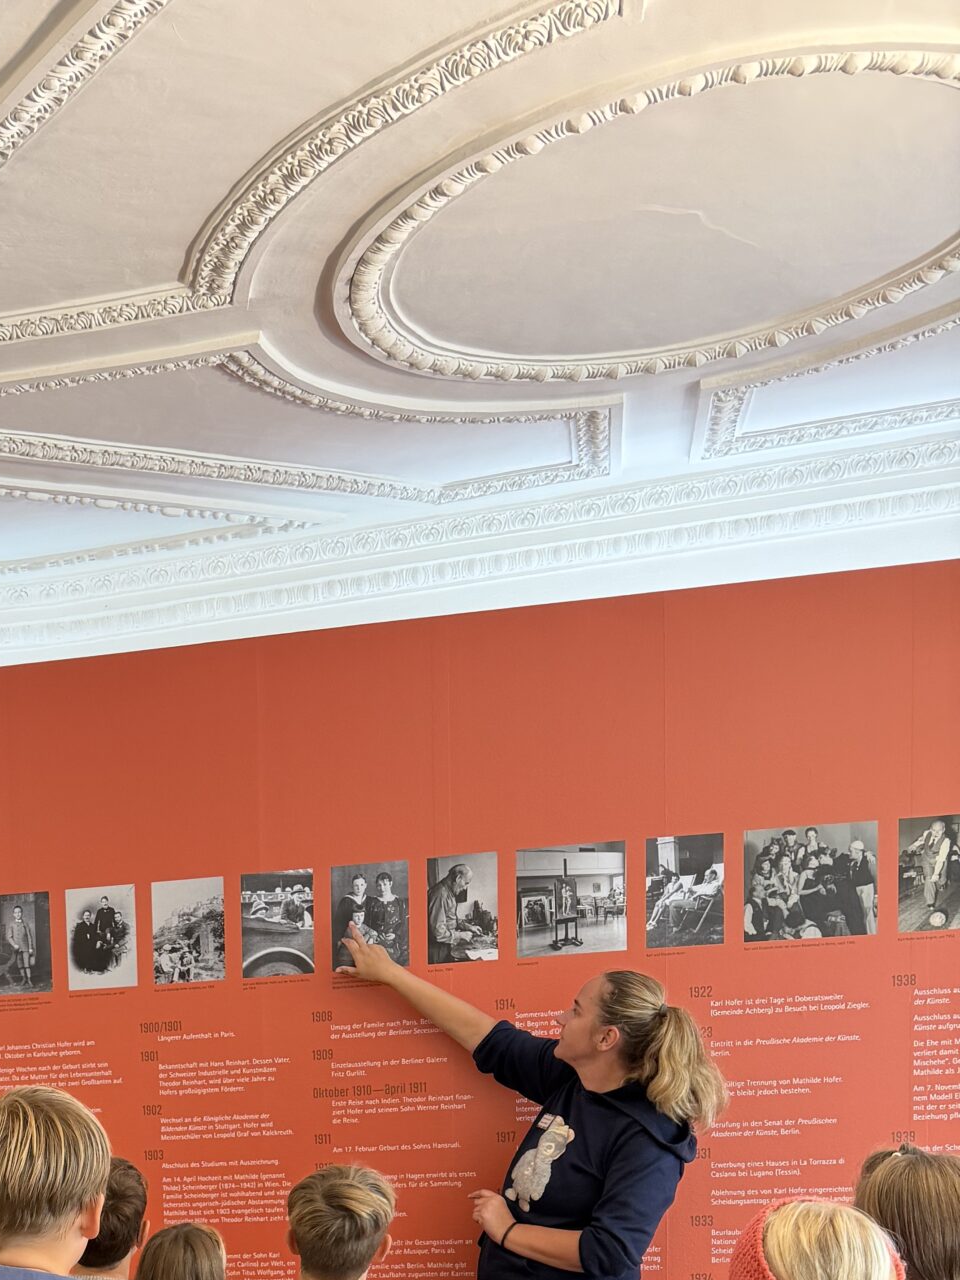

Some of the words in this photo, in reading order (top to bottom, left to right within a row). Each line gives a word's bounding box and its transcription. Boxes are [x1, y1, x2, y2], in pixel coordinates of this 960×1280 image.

[892, 974, 916, 986] 1938
[690, 986, 712, 997] 1922
[495, 999, 515, 1010] 1914
[710, 999, 723, 1007] Karl
[725, 998, 743, 1006] Hofer
[745, 997, 753, 1005] ist
[755, 997, 767, 1005] drei
[769, 996, 785, 1005] Tage
[795, 993, 843, 1002] Doberatsweiler
[710, 1007, 743, 1018] (Gemeinde
[745, 1006, 774, 1015] Achberg)
[785, 1004, 807, 1012] Besuch
[809, 1003, 819, 1011] bei
[820, 1002, 845, 1012] Leopold
[847, 1001, 870, 1011] Ziegler.
[312, 1011, 332, 1022] 1908
[140, 1021, 182, 1033] 1900/1901
[330, 1023, 351, 1031] Umzug
[363, 1020, 384, 1028] Familie
[386, 1019, 401, 1027] nach
[402, 1018, 418, 1026] Paris.
[341, 1030, 375, 1039] Ausstellung
[389, 1028, 412, 1036] Berliner
[710, 1039, 733, 1048] Eintritt
[743, 1038, 753, 1046] die
[914, 1039, 925, 1047] Die
[941, 1038, 952, 1046] mit
[140, 1051, 159, 1061] 1901
[312, 1049, 333, 1060] 1909
[913, 1048, 937, 1057] verliert
[939, 1047, 959, 1055] damit
[331, 1059, 381, 1068] Einzelausstellung
[382, 1058, 388, 1066] in
[401, 1057, 424, 1065] Berliner
[426, 1055, 448, 1063] Galerie
[913, 1068, 943, 1076] Mathilde
[945, 1067, 955, 1075] als
[747, 1078, 776, 1087] Trennung
[792, 1076, 821, 1084] Mathilde
[313, 1087, 350, 1098] Oktober
[409, 1082, 427, 1093] 1911
[737, 1088, 755, 1096] bleibt
[757, 1087, 779, 1097] jedoch
[930, 1092, 952, 1101] Modell
[142, 1105, 162, 1115] 1902
[332, 1108, 345, 1116] ziert
[347, 1107, 363, 1115] Hofer
[365, 1106, 376, 1114] und
[416, 1104, 439, 1112] Werner
[440, 1102, 466, 1111] Reinhart
[913, 1103, 924, 1111] mit
[913, 1112, 948, 1121] Beziehung
[314, 1134, 331, 1144] 1911
[496, 1131, 516, 1143] 1917
[891, 1131, 915, 1143] 1939
[333, 1145, 343, 1153] Am
[355, 1144, 377, 1152] Februar
[379, 1143, 399, 1151] Geburt
[413, 1142, 431, 1150] Sohns
[144, 1150, 164, 1160] 1903
[711, 1161, 745, 1169] Erwerbung
[809, 1158, 837, 1166] Torrazza
[839, 1157, 845, 1165] di
[738, 1169, 748, 1177] bei
[750, 1169, 773, 1178] Lugano
[711, 1189, 745, 1197] Ablehnung
[773, 1187, 787, 1195] Karl
[809, 1186, 853, 1195] eingereichten
[690, 1216, 714, 1226] 1933
